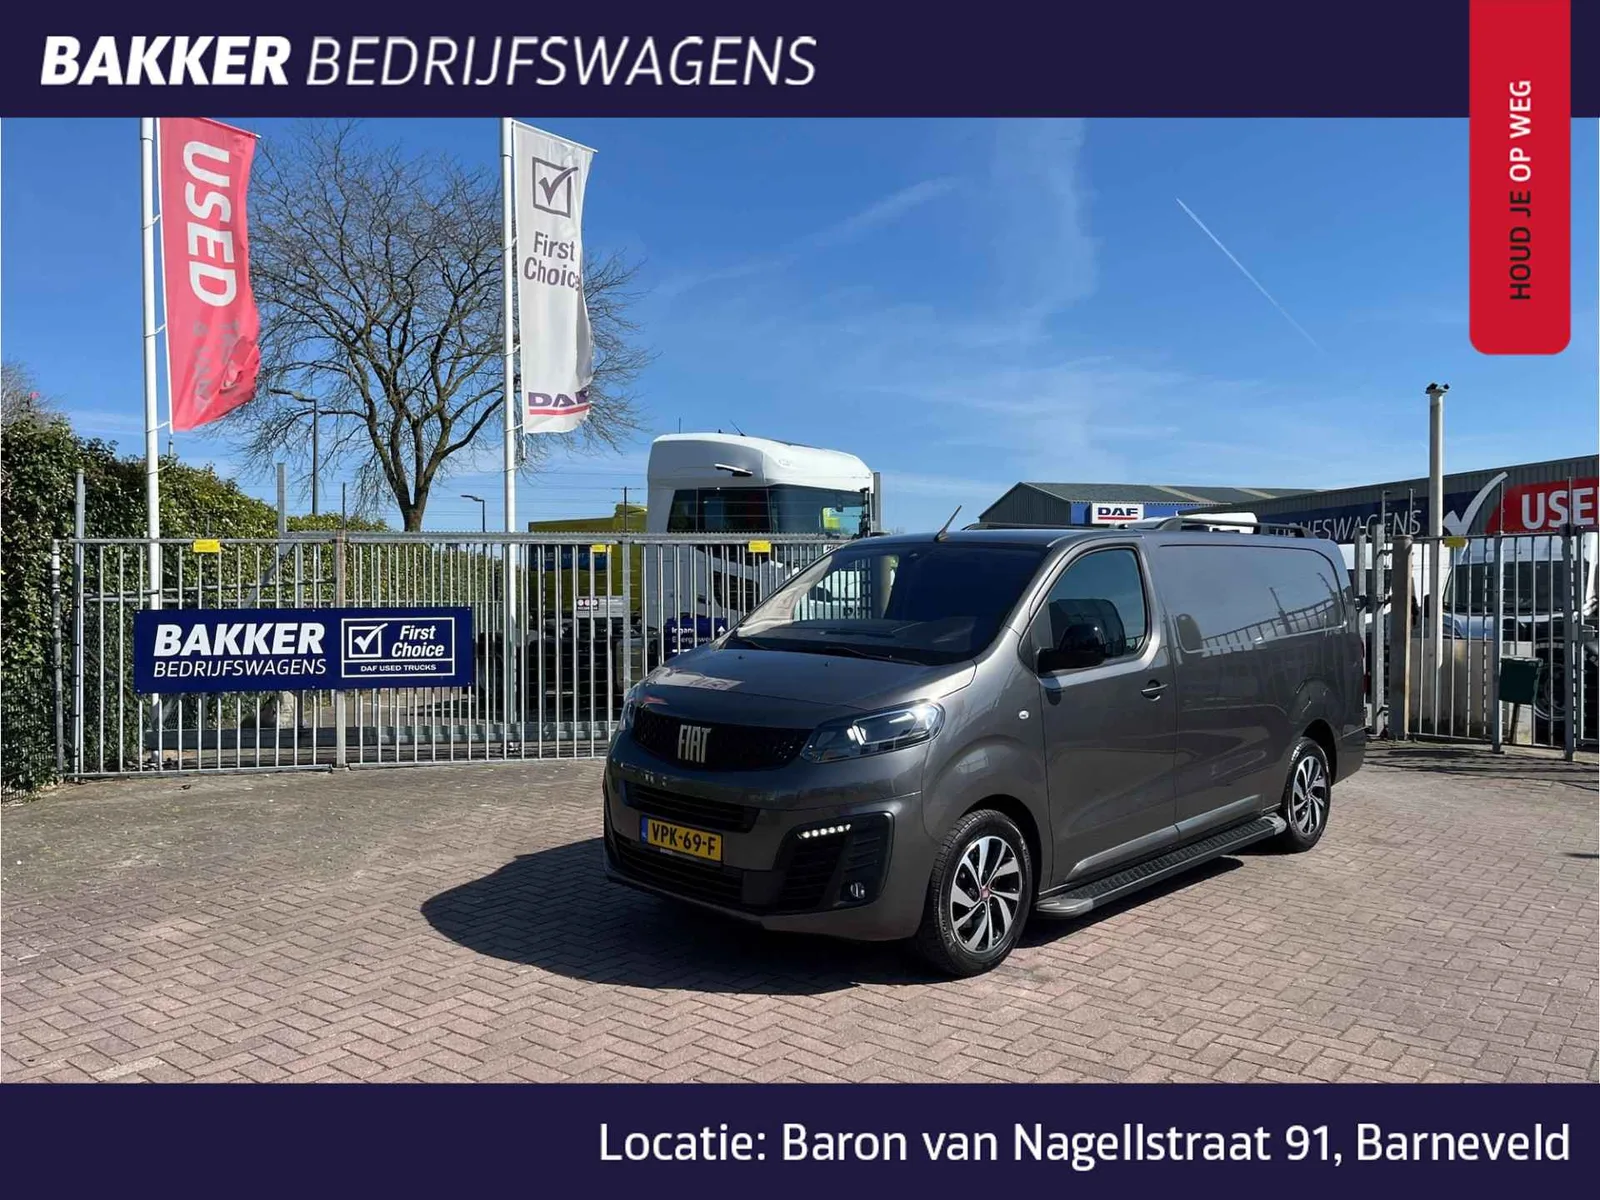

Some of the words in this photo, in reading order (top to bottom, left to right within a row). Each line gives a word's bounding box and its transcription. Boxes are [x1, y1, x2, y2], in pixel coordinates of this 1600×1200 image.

[183, 140, 237, 307] USED
[534, 231, 575, 262] First
[1097, 506, 1138, 517] DAF
[1521, 487, 1599, 530] USE
[153, 622, 325, 657] BAKKER
[399, 625, 437, 641] First
[391, 641, 445, 658] Choice
[153, 658, 327, 678] BEDRIJFSWAGENS
[379, 664, 402, 672] USED
[677, 724, 712, 763] FIAT
[651, 822, 717, 856] VPK-69-F
